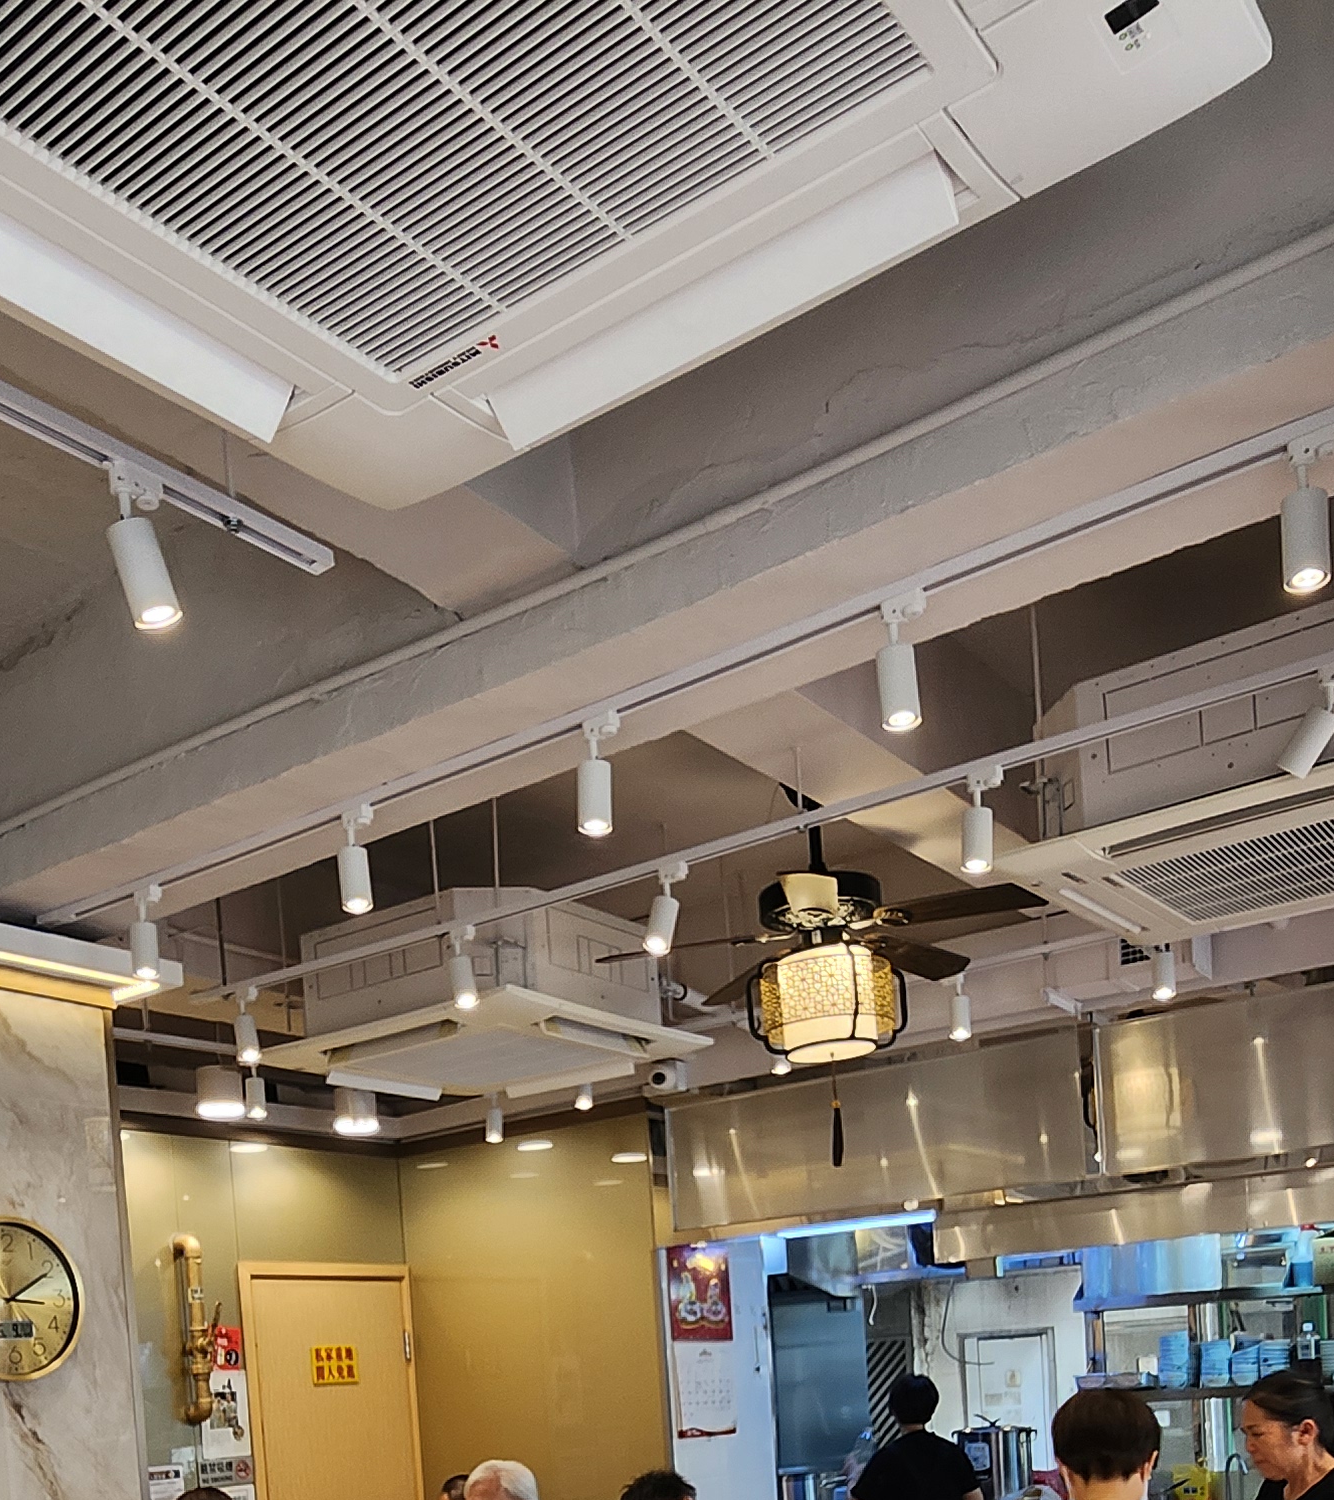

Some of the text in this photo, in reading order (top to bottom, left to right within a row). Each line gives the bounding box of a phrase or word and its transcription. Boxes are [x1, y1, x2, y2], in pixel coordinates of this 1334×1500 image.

[41, 1260, 54, 1278] 2
[52, 1289, 65, 1308] 3
[48, 1315, 60, 1333] 4
[9, 1346, 23, 1365] 6
[32, 1337, 46, 1357] 5
